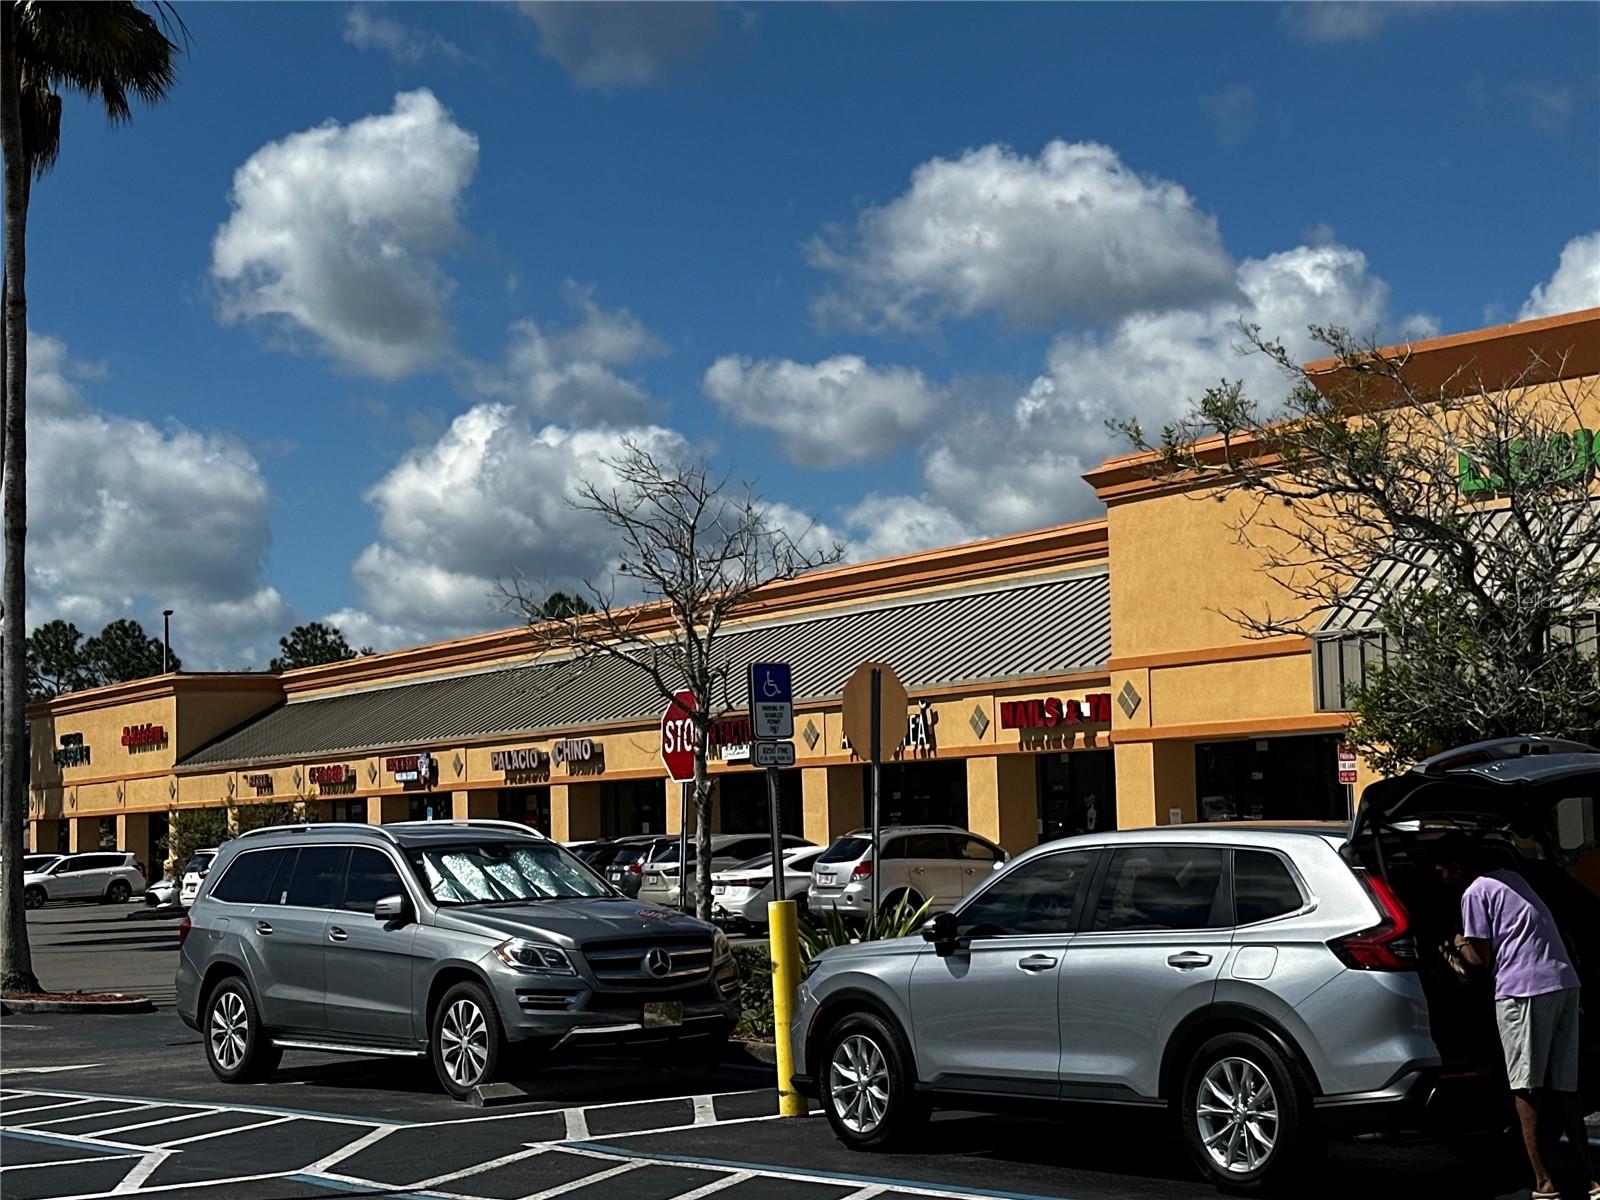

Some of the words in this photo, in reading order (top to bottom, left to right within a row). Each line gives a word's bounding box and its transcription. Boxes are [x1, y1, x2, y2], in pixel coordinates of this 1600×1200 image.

[1001, 698, 1057, 729] NAILS
[1066, 699, 1082, 725] &
[664, 718, 701, 753] STO
[492, 749, 539, 770] PALACIO
[555, 739, 591, 761] CHINO
